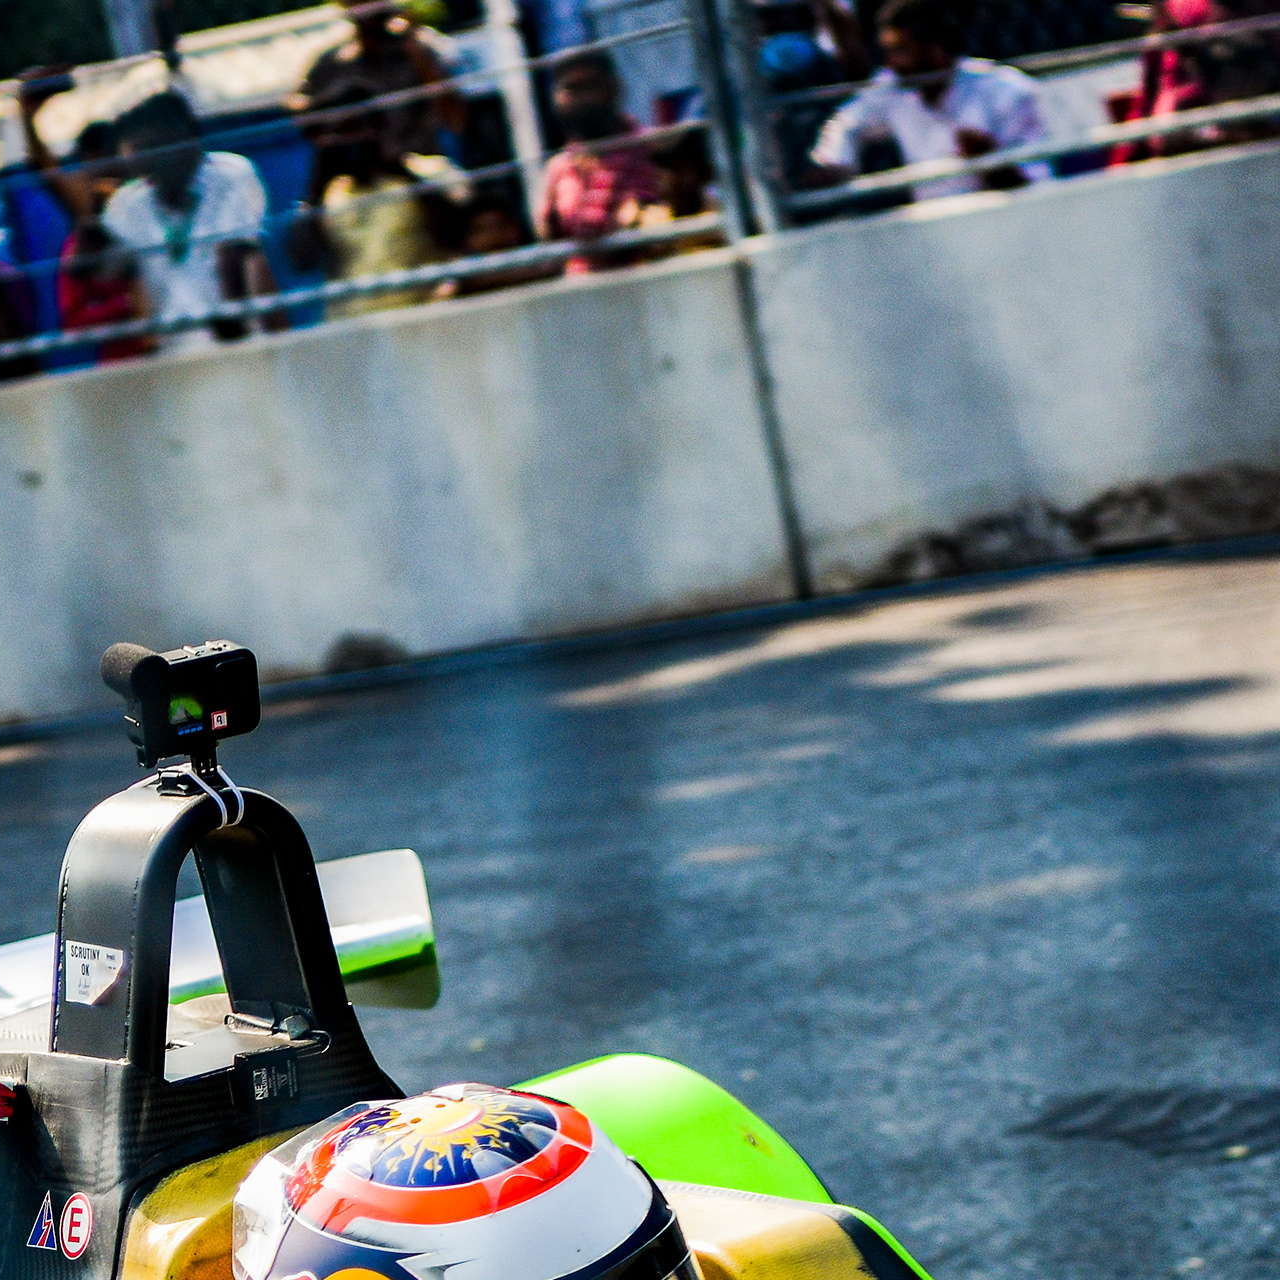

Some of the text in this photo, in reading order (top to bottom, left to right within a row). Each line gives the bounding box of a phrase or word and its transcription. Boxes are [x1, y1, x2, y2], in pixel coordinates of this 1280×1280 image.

[71, 945, 100, 960] SCRUTINY
[81, 963, 90, 976] OK
[68, 1208, 83, 1243] E
